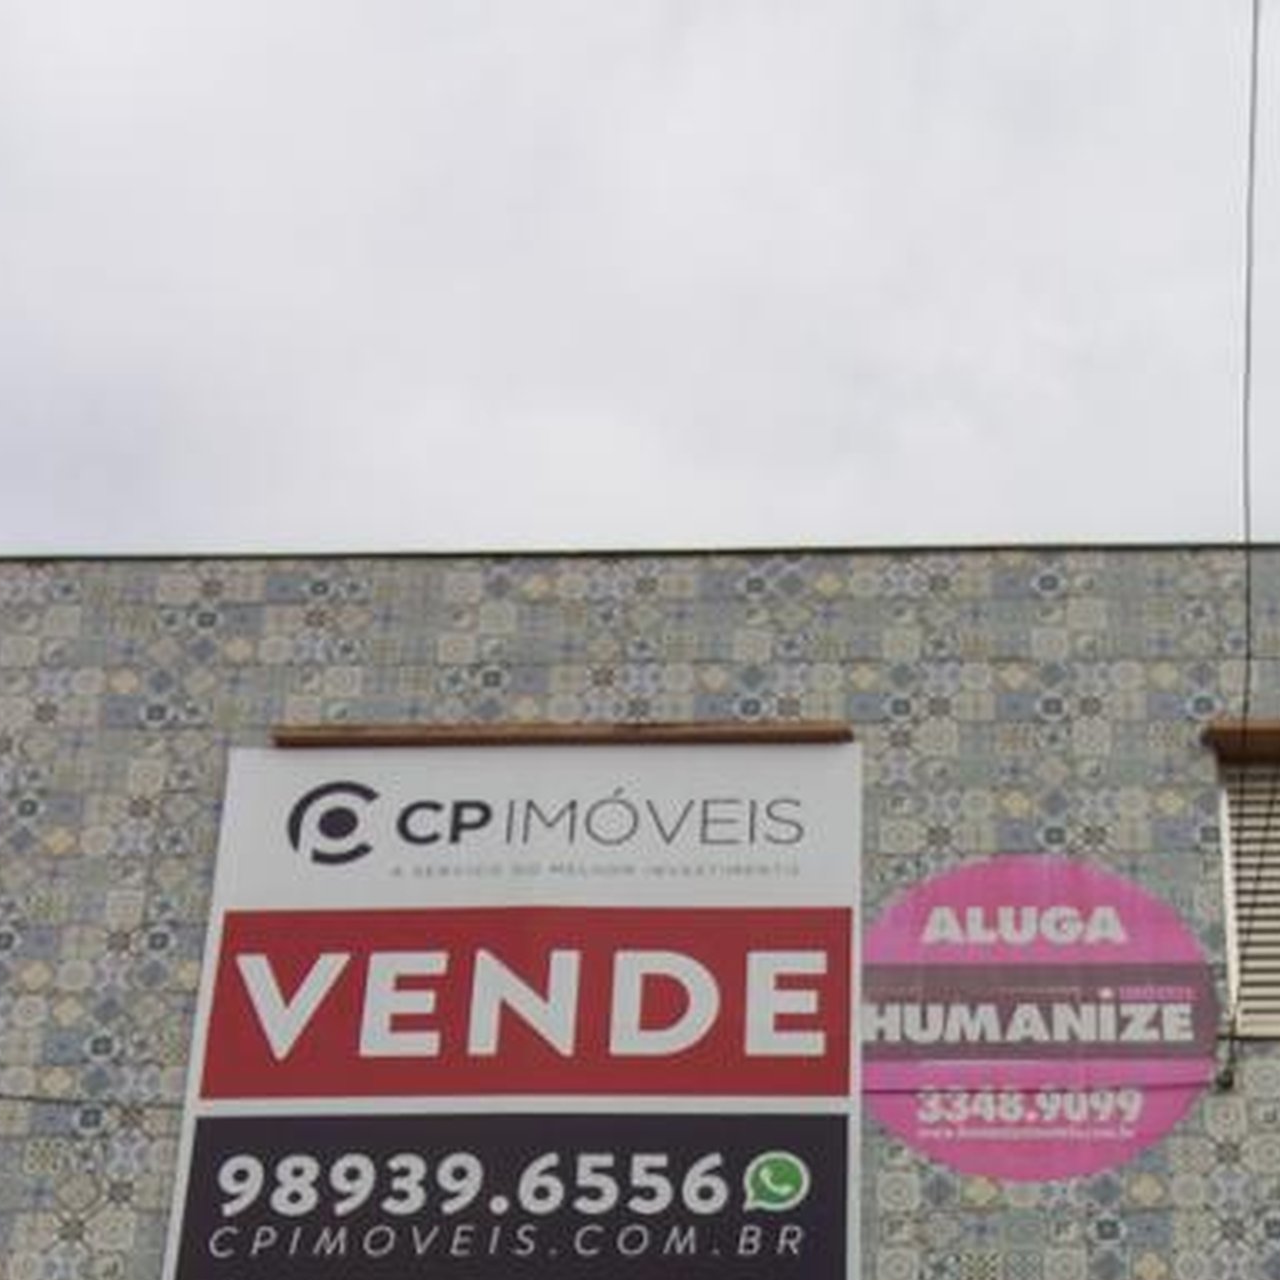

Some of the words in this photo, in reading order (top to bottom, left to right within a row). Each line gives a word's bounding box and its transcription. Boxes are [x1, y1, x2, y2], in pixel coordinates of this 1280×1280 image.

[922, 906, 1127, 944] ALUGA
[236, 949, 827, 1061] VENDE
[917, 1085, 1143, 1122] 3348.9099
[217, 1152, 728, 1216] 98939.6556
[208, 1224, 806, 1257] CPIMOVEIS.COM.BR
